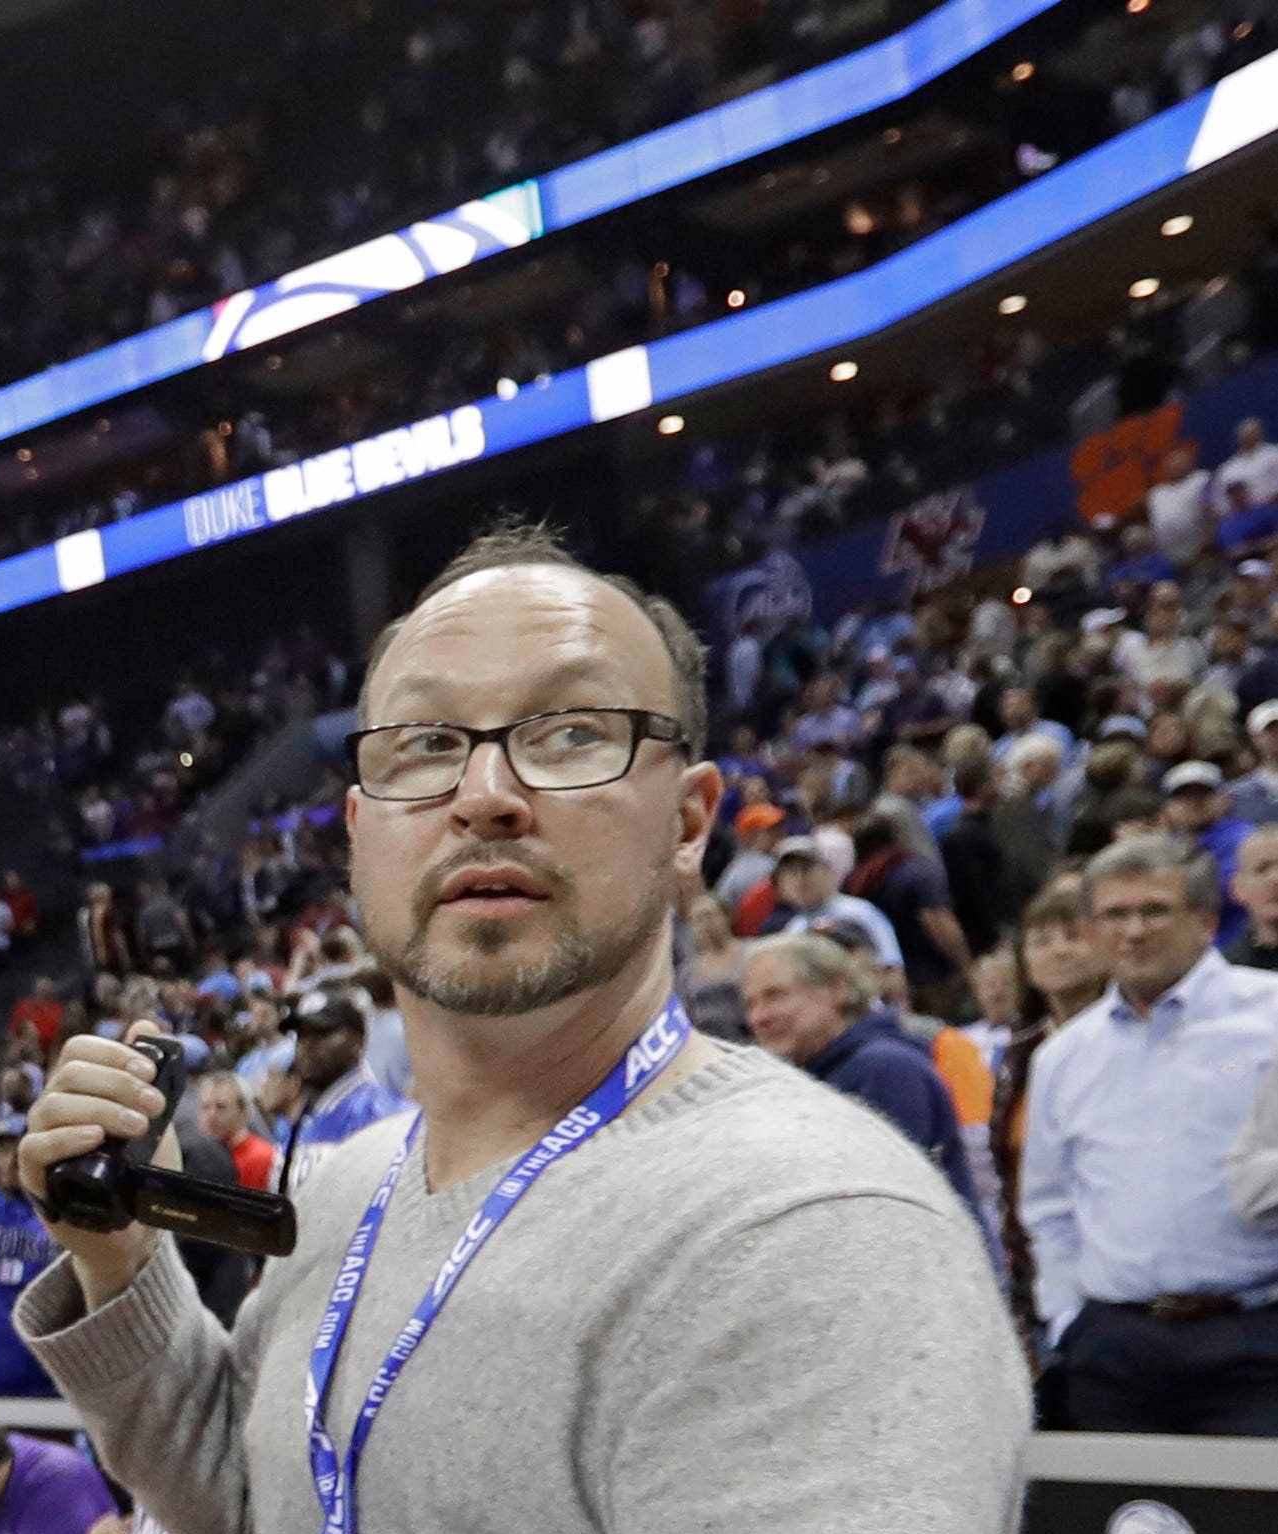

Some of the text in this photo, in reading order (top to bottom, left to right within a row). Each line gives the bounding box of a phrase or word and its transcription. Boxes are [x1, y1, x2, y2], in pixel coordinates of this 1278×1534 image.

[183, 404, 486, 547] DUKE BLUE DEVILS
[624, 1011, 679, 1091] ACC
[432, 1210, 492, 1297] ACC
